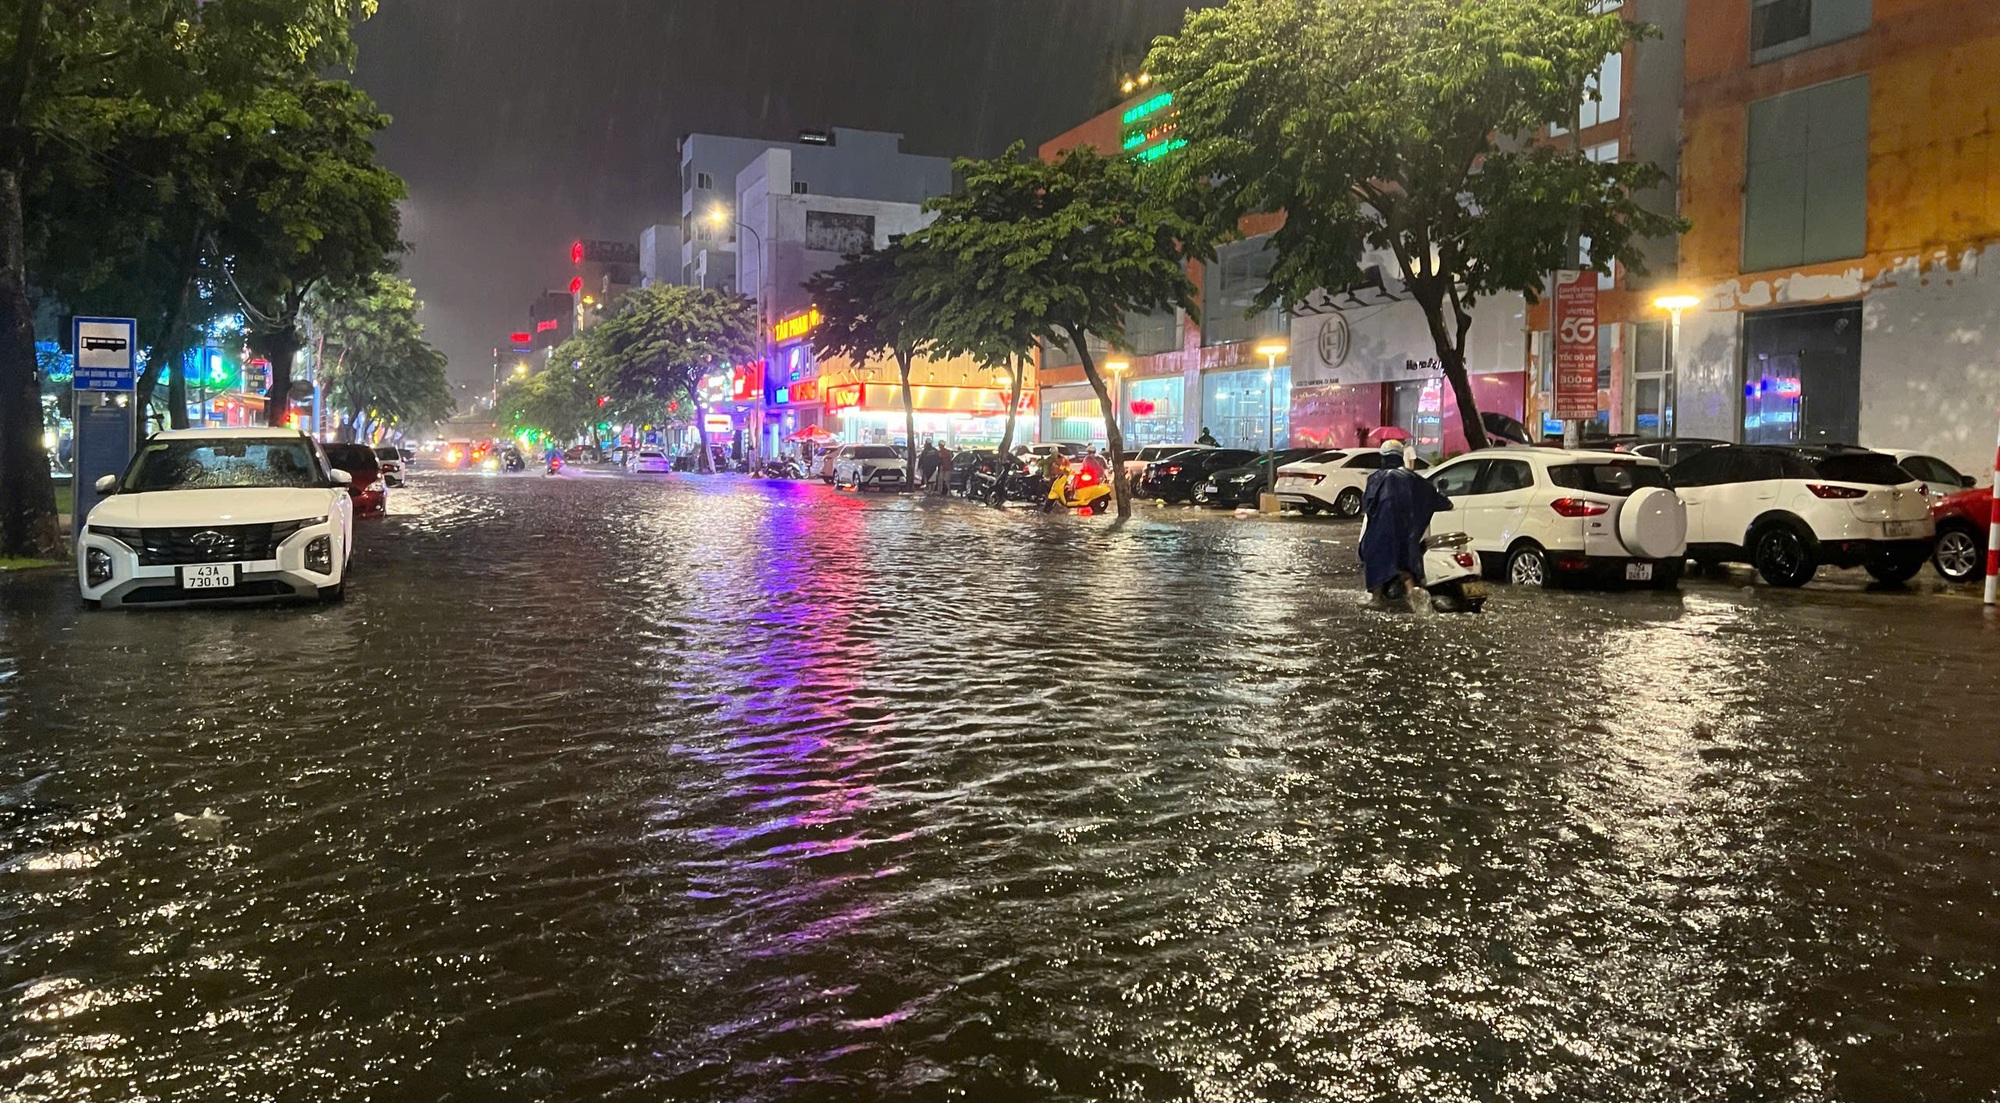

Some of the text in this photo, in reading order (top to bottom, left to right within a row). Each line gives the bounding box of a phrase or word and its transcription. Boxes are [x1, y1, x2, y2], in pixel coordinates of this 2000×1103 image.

[1560, 317, 1595, 343] 5G
[198, 566, 219, 576] 43A
[189, 576, 229, 587] 730.10
